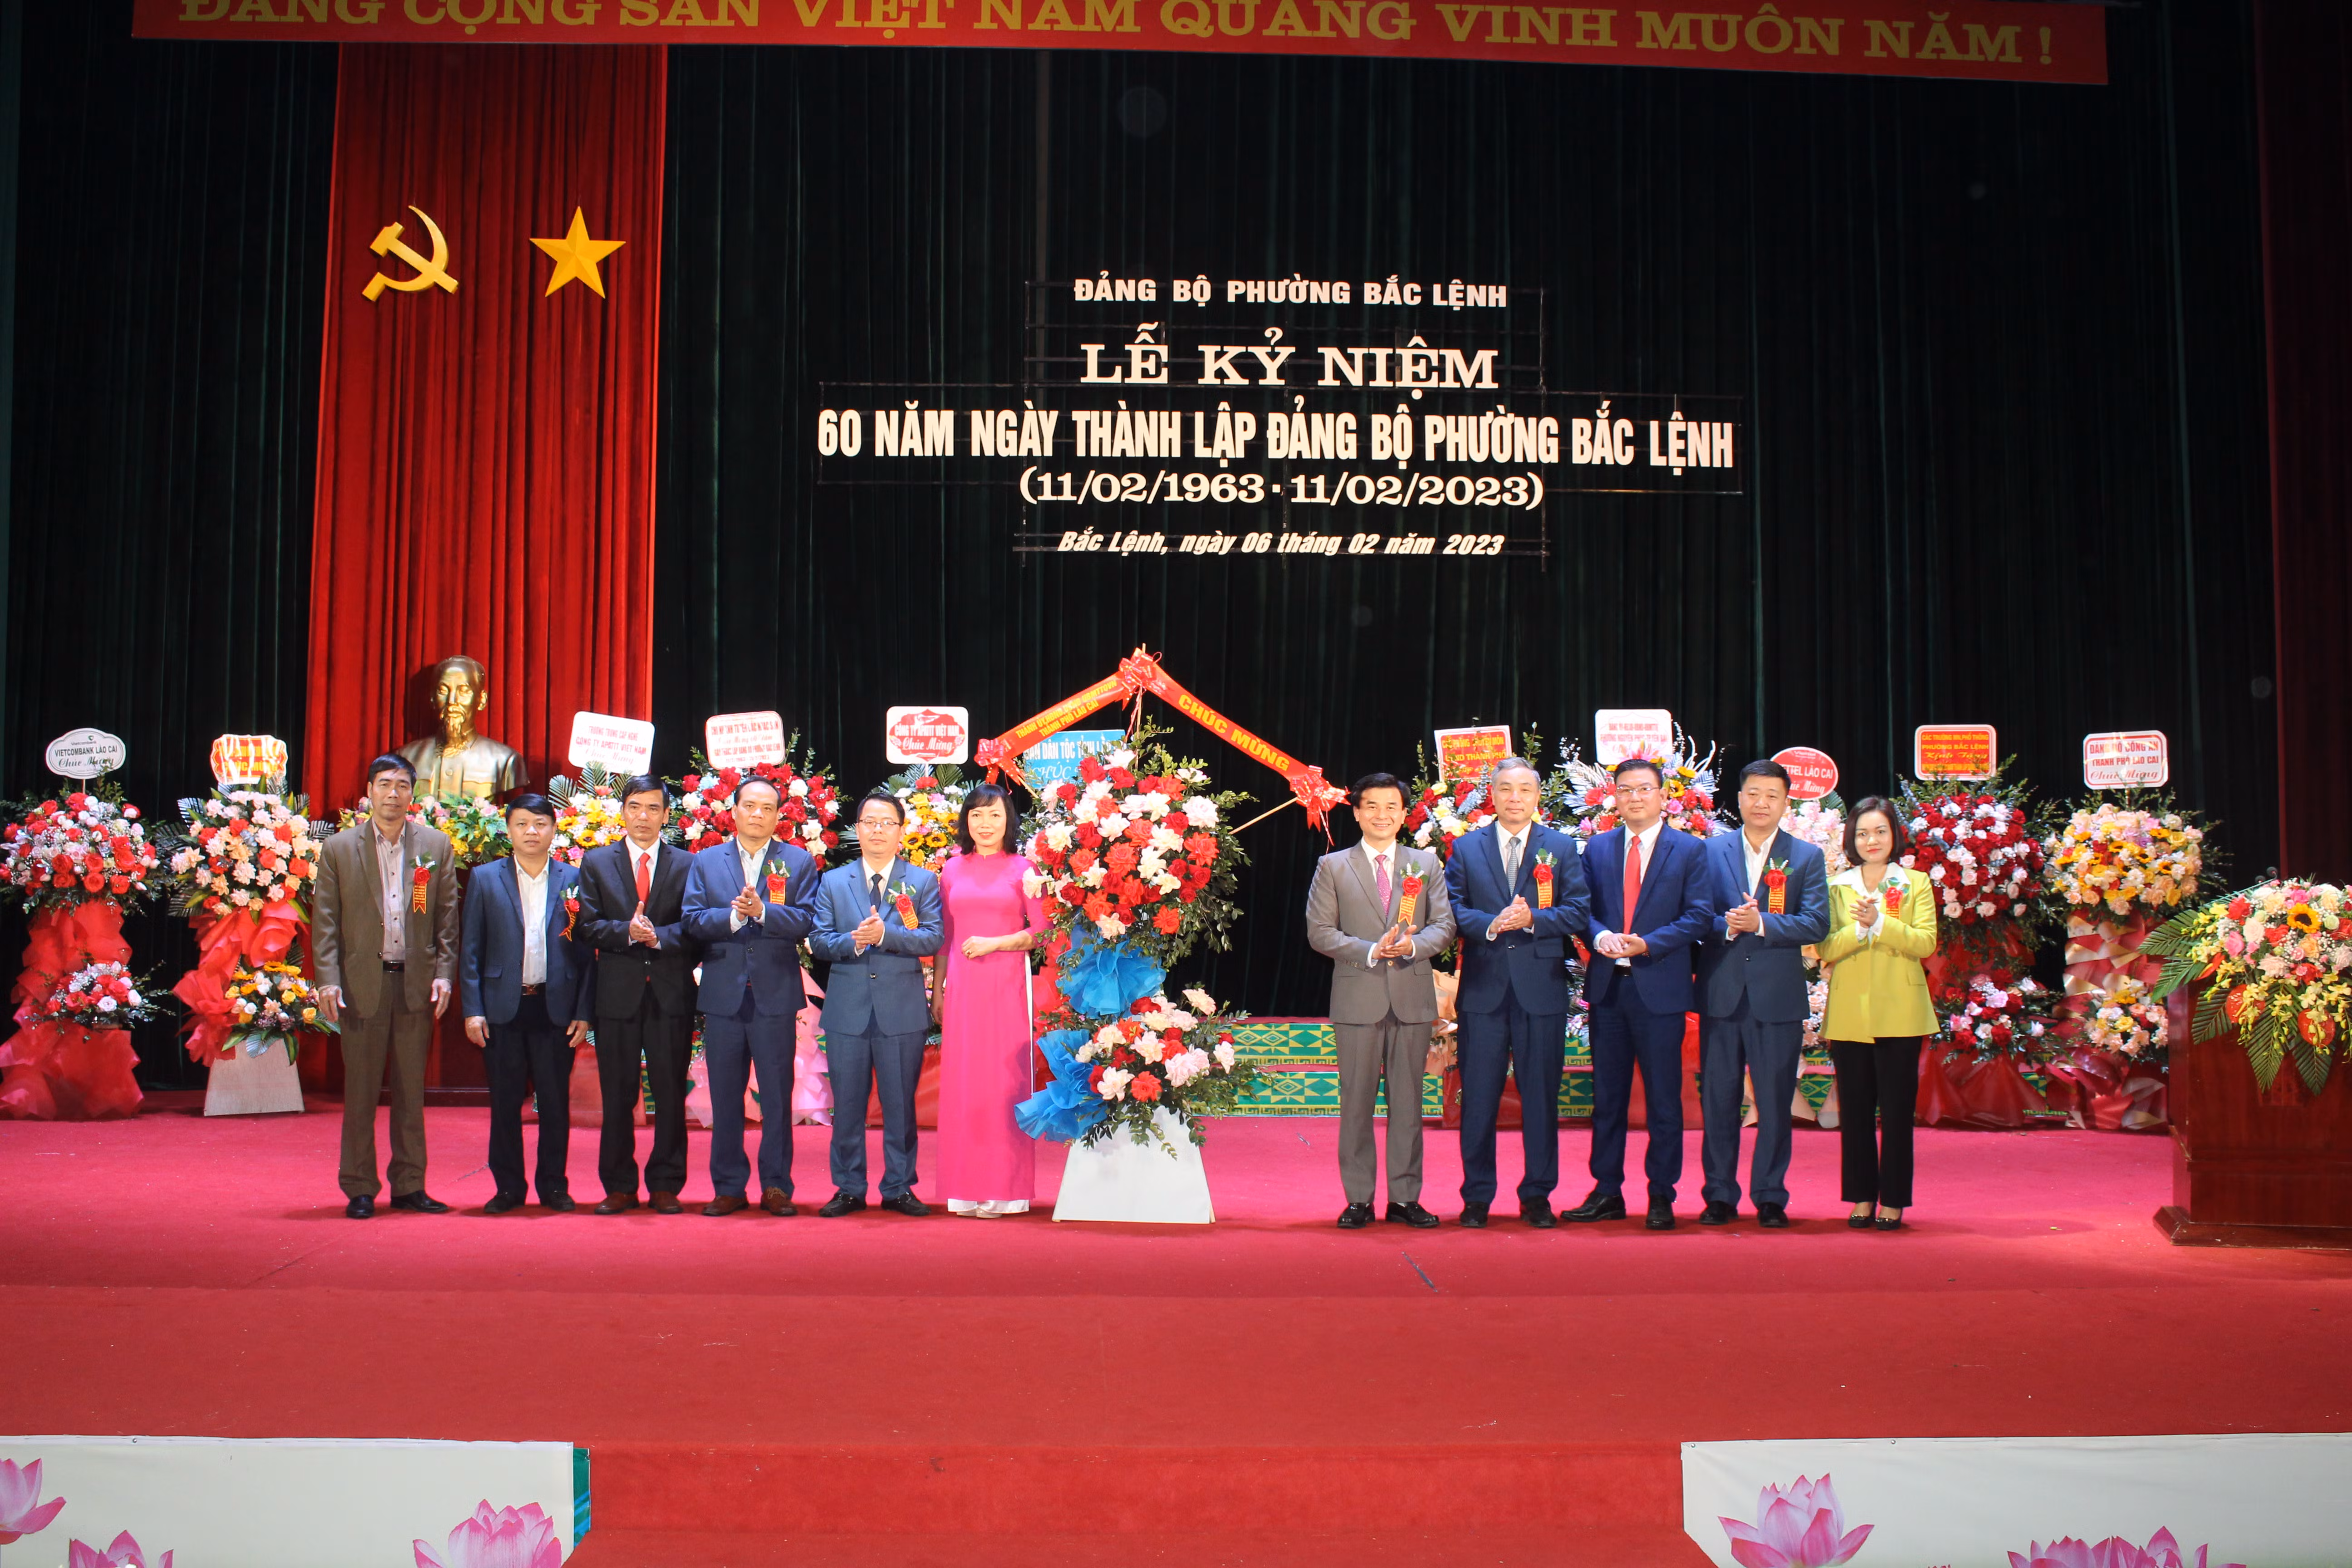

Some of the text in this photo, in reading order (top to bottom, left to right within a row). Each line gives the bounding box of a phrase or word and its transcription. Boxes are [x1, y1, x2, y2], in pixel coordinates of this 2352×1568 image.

[973, 0, 1141, 33] NAM
[1160, 0, 1417, 39] QUANG
[1436, 3, 1618, 47] VINH
[1635, 3, 1845, 56] MUÔN
[1863, 11, 2023, 63] NĂM
[1074, 271, 1506, 311] ĐẢNG BỘ PHƯỜNG BẮC LỆNH
[1081, 322, 1498, 400] LỄ KỶ NIỆM
[818, 395, 1732, 475] 60 NĂM NGÀY THÀNH LẬP ĐẢNG BỘ PHƯỜNG BẮC LỆNH
[1057, 526, 1504, 556] Bắc Lệnh, ngày 06 tháng 02 năm 2023
[1073, 706, 1088, 719] LÀO
[1086, 699, 1099, 711] CAI
[894, 723, 909, 736] CÔNG
[910, 725, 916, 736] TY
[935, 723, 947, 738] VIỆT
[947, 725, 960, 736] NAM
[1178, 694, 1290, 771] CHÚC MỪNG
[54, 747, 94, 757] VIETCOMBANK
[95, 745, 107, 754] LÀO
[902, 737, 953, 754] Chúc Mừng
[1024, 743, 1041, 760] AN
[1042, 738, 1059, 760] DÂN
[1060, 738, 1075, 763] TỘC
[1954, 741, 1969, 750] BẮC
[2125, 740, 2146, 752] CÔNG
[58, 758, 82, 768] Chúc
[1466, 752, 1490, 760] THÀNH
[2147, 756, 2159, 764] CAI
[1804, 764, 1820, 777] LÀO
[1821, 769, 1834, 779] CAI
[1801, 780, 1826, 795] Mừng
